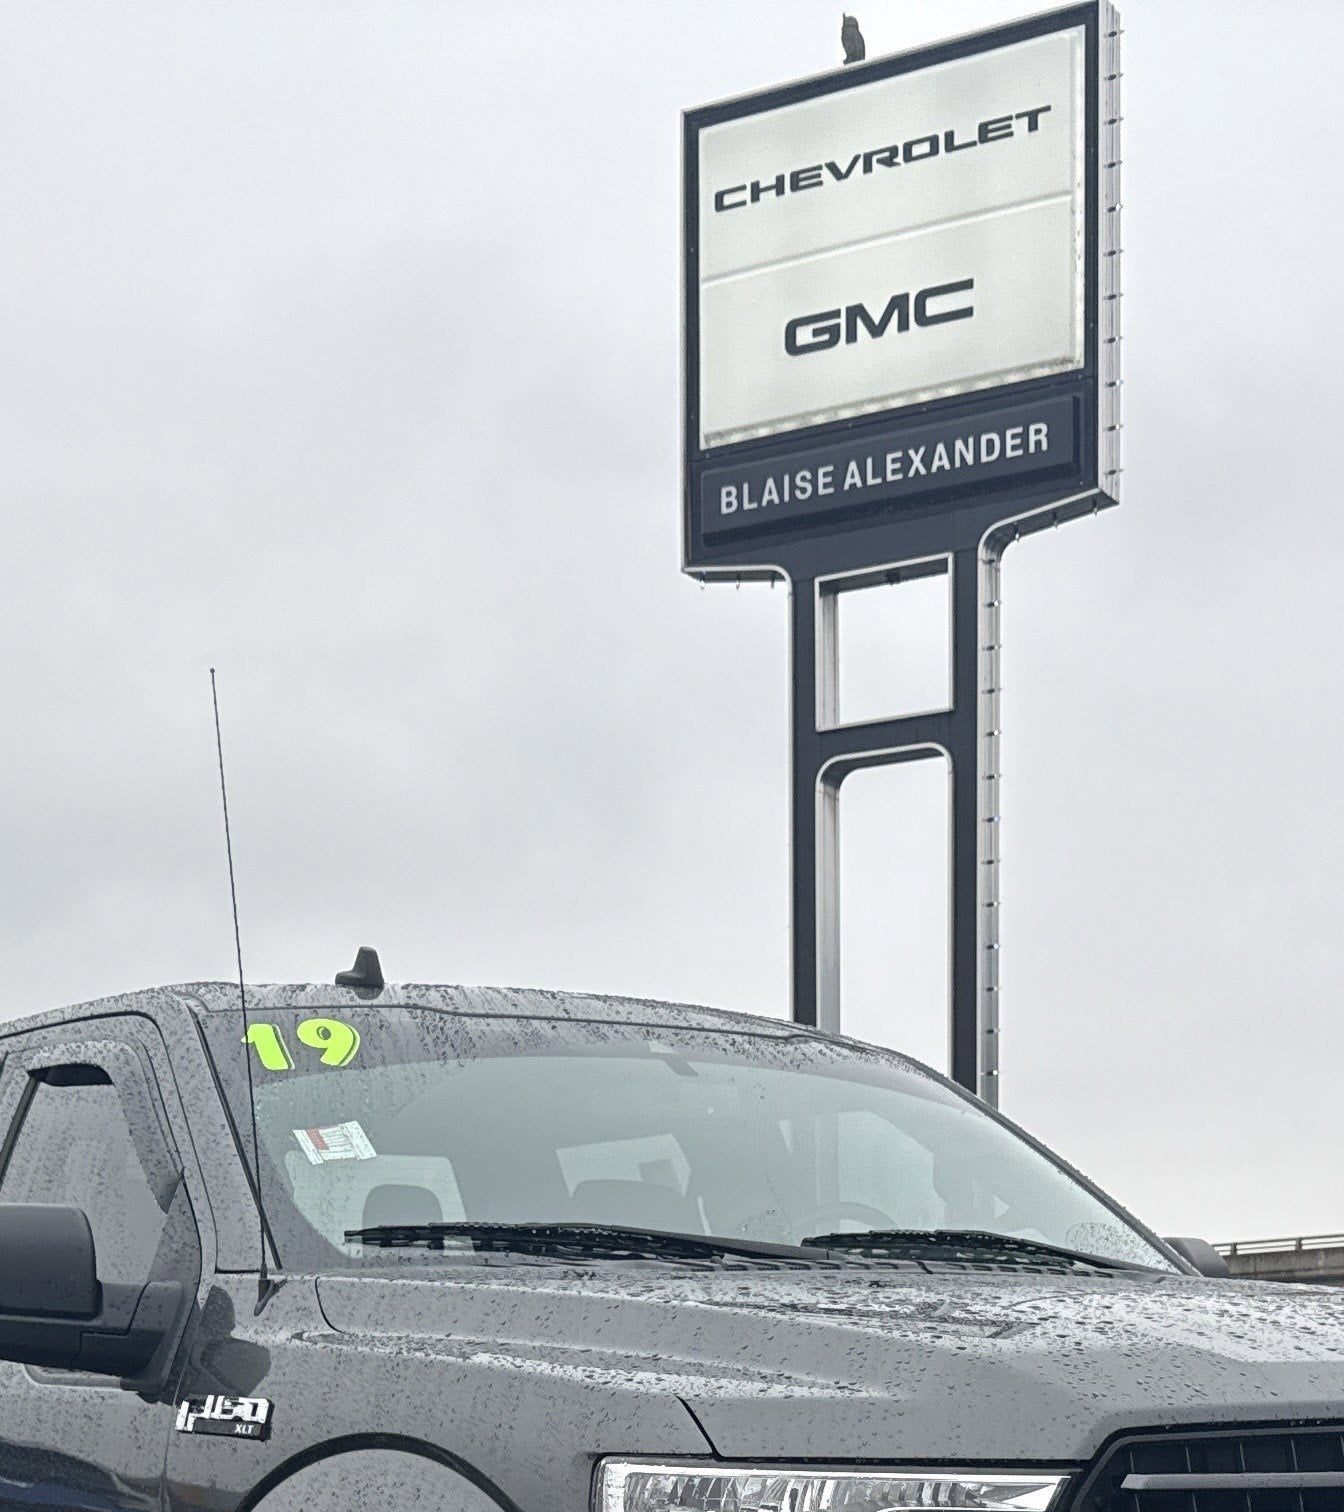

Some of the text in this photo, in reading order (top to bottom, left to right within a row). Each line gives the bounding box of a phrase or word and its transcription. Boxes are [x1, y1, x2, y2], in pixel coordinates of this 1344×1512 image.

[714, 104, 1051, 213] CHEVROLET
[784, 278, 974, 357] GMC
[720, 421, 1049, 515] BLAISE ALEXANDER
[240, 1017, 361, 1071] 19
[234, 1423, 254, 1434] XLT
